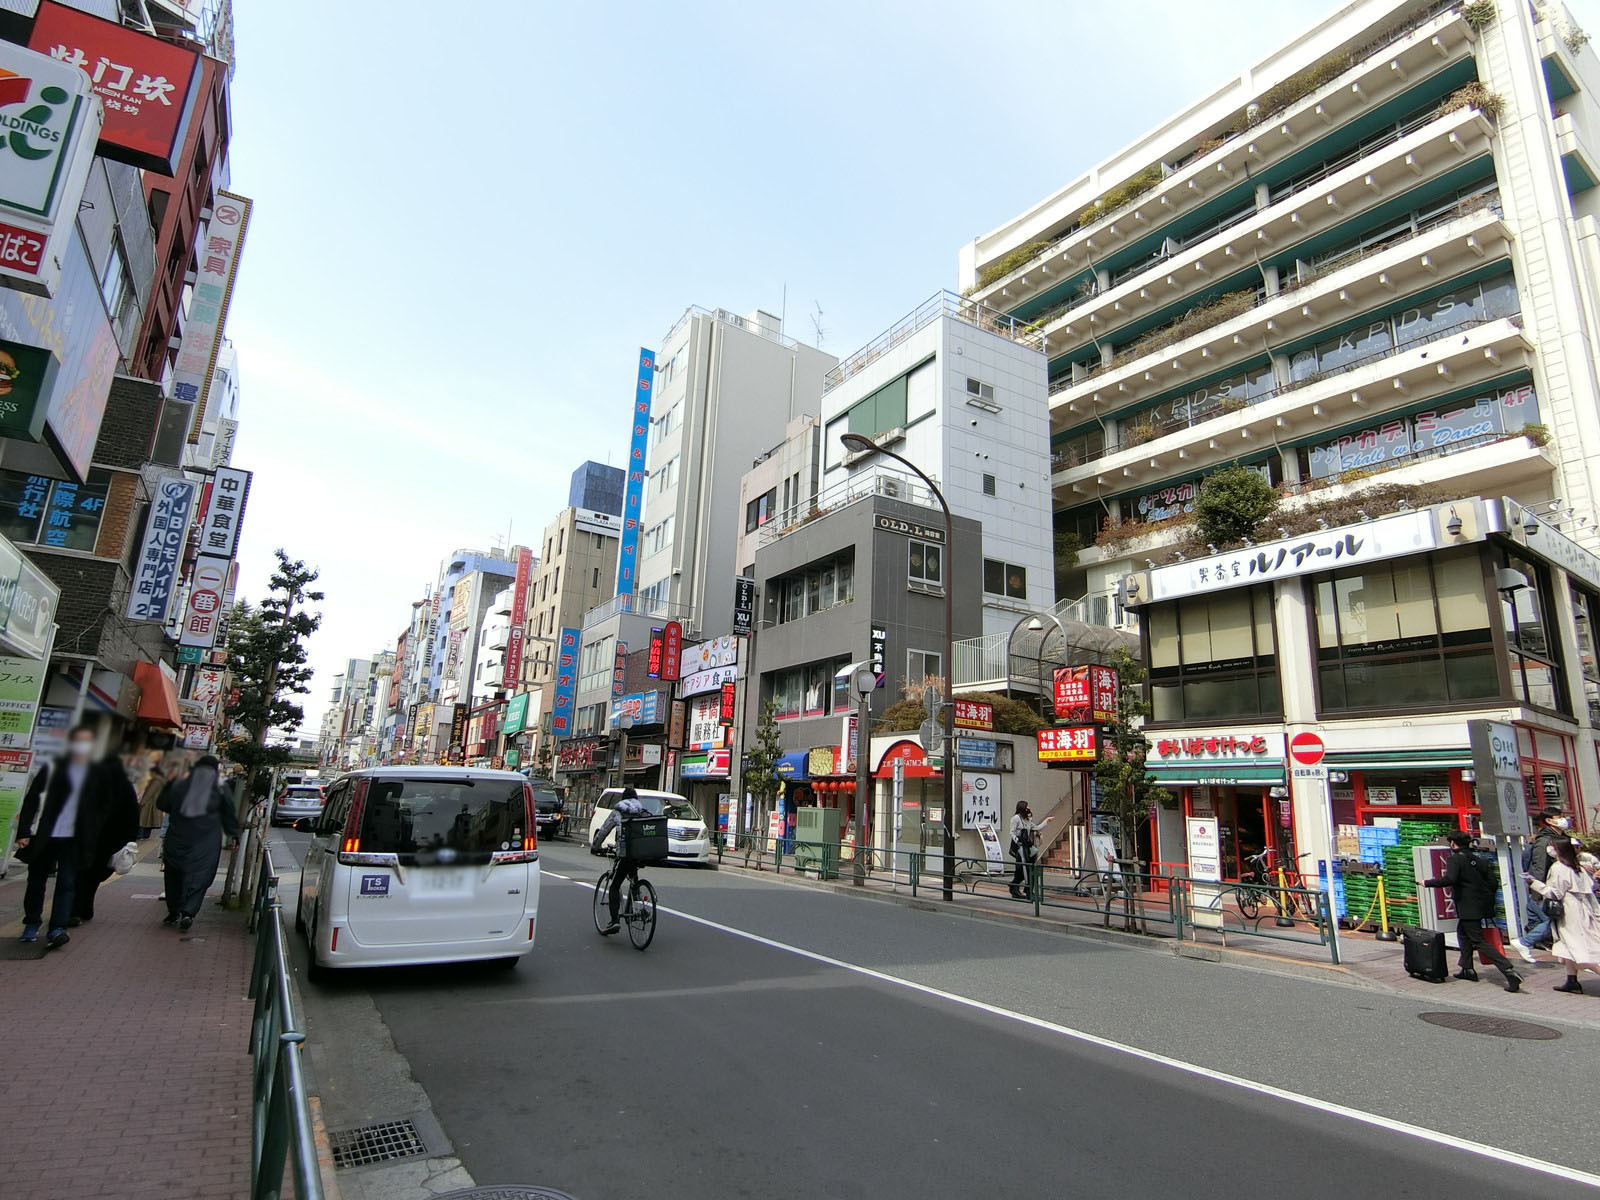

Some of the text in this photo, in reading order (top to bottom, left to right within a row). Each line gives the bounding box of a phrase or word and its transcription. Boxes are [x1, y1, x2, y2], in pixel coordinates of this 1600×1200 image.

[0, 112, 61, 143] LDINGS
[203, 234, 233, 277] 家具
[1331, 385, 1534, 452] アカデミー 4F
[1340, 447, 1387, 471] Shall
[1431, 419, 1494, 447] Dance
[80, 496, 105, 512] 4F
[207, 477, 239, 549] 中華食堂
[137, 499, 173, 594] 外国人専門店
[152, 501, 186, 600] JBCモバイル
[1199, 534, 1366, 585] 喫茶室 ルノアール
[515, 557, 529, 623] PLAZA HOTEL
[134, 602, 162, 617] 2F
[187, 575, 221, 634] 一番館
[736, 612, 750, 622] XU
[871, 629, 886, 640] XU
[873, 642, 883, 674] 不動産
[552, 634, 576, 729] カラオケ館
[1098, 669, 1113, 712] 海羽
[699, 696, 719, 720] 華僑
[967, 703, 989, 722] 海羽
[694, 721, 720, 741] 服務社
[1040, 731, 1055, 741] 中国
[1056, 729, 1089, 750] 海羽
[1156, 735, 1267, 757] まいばすけっと
[1199, 777, 1236, 785] まいばすけっと
[1294, 768, 1325, 777] 自転車を除く
[963, 810, 998, 825] ルノアール
